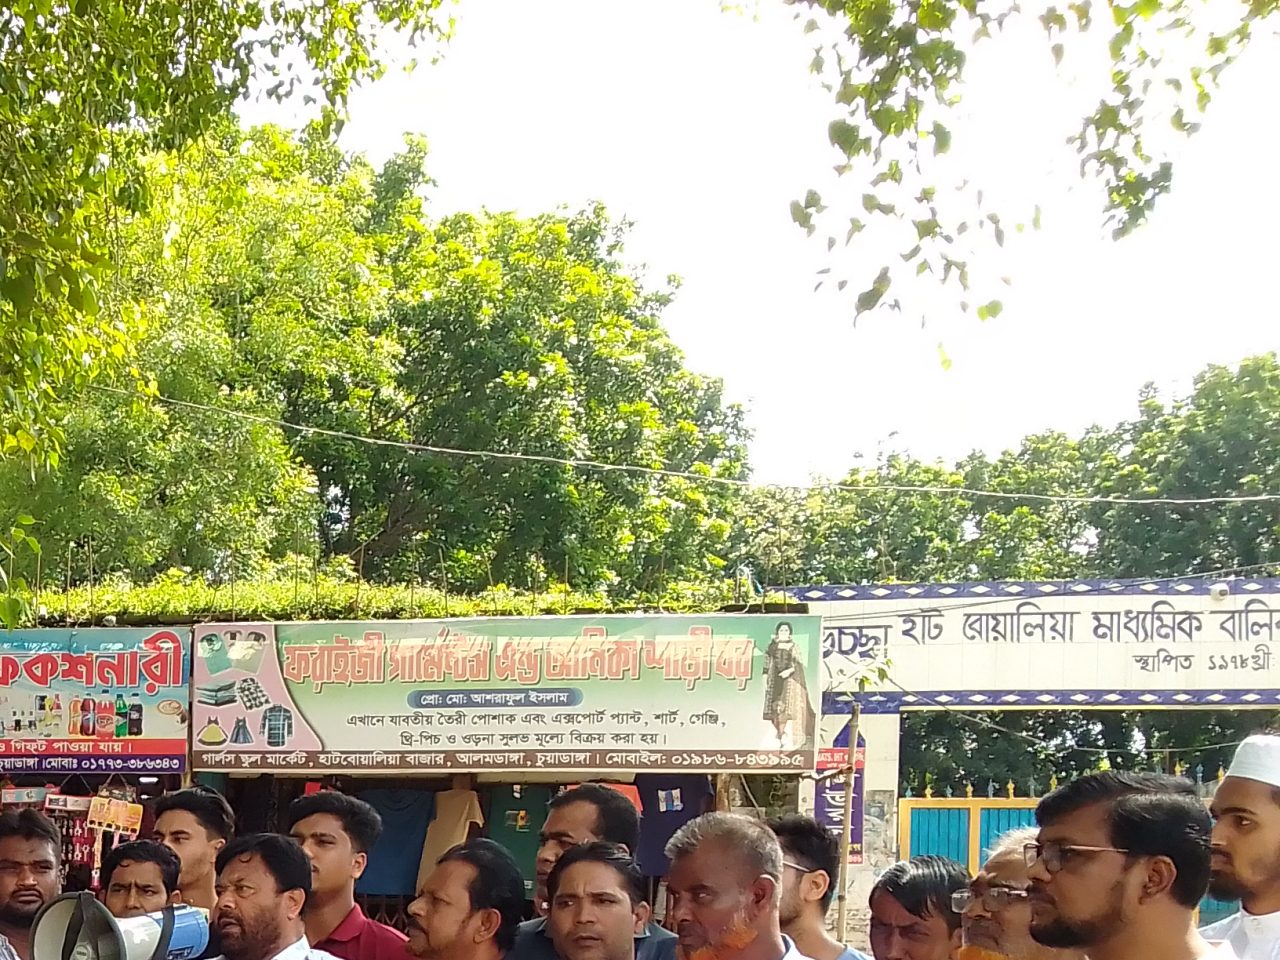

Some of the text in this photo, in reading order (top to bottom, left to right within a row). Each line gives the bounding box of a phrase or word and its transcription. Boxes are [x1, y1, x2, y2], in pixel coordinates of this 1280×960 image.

[898, 599, 1280, 645] হাট বোয়ালিয়া মাধ্যমিক বালি
[1132, 648, 1195, 672] স্থাপিত
[528, 690, 568, 703] ইসলাম
[346, 714, 384, 727] এখানে
[389, 711, 433, 726] যাবতীয়
[471, 712, 517, 726] পোশাক
[521, 712, 547, 726] এবং
[551, 709, 605, 726] এক্সপোর্ট
[52, 740, 93, 753] পাওয়া
[446, 734, 456, 744] ও
[461, 733, 495, 747] ওড়না
[499, 733, 530, 747] সুলভ
[535, 732, 565, 747] মূল্যে
[569, 730, 605, 745] বিক্রয়
[609, 732, 636, 744] করা
[201, 751, 235, 765] গার্লস
[318, 751, 401, 766] হাটবোয়ালিয়া
